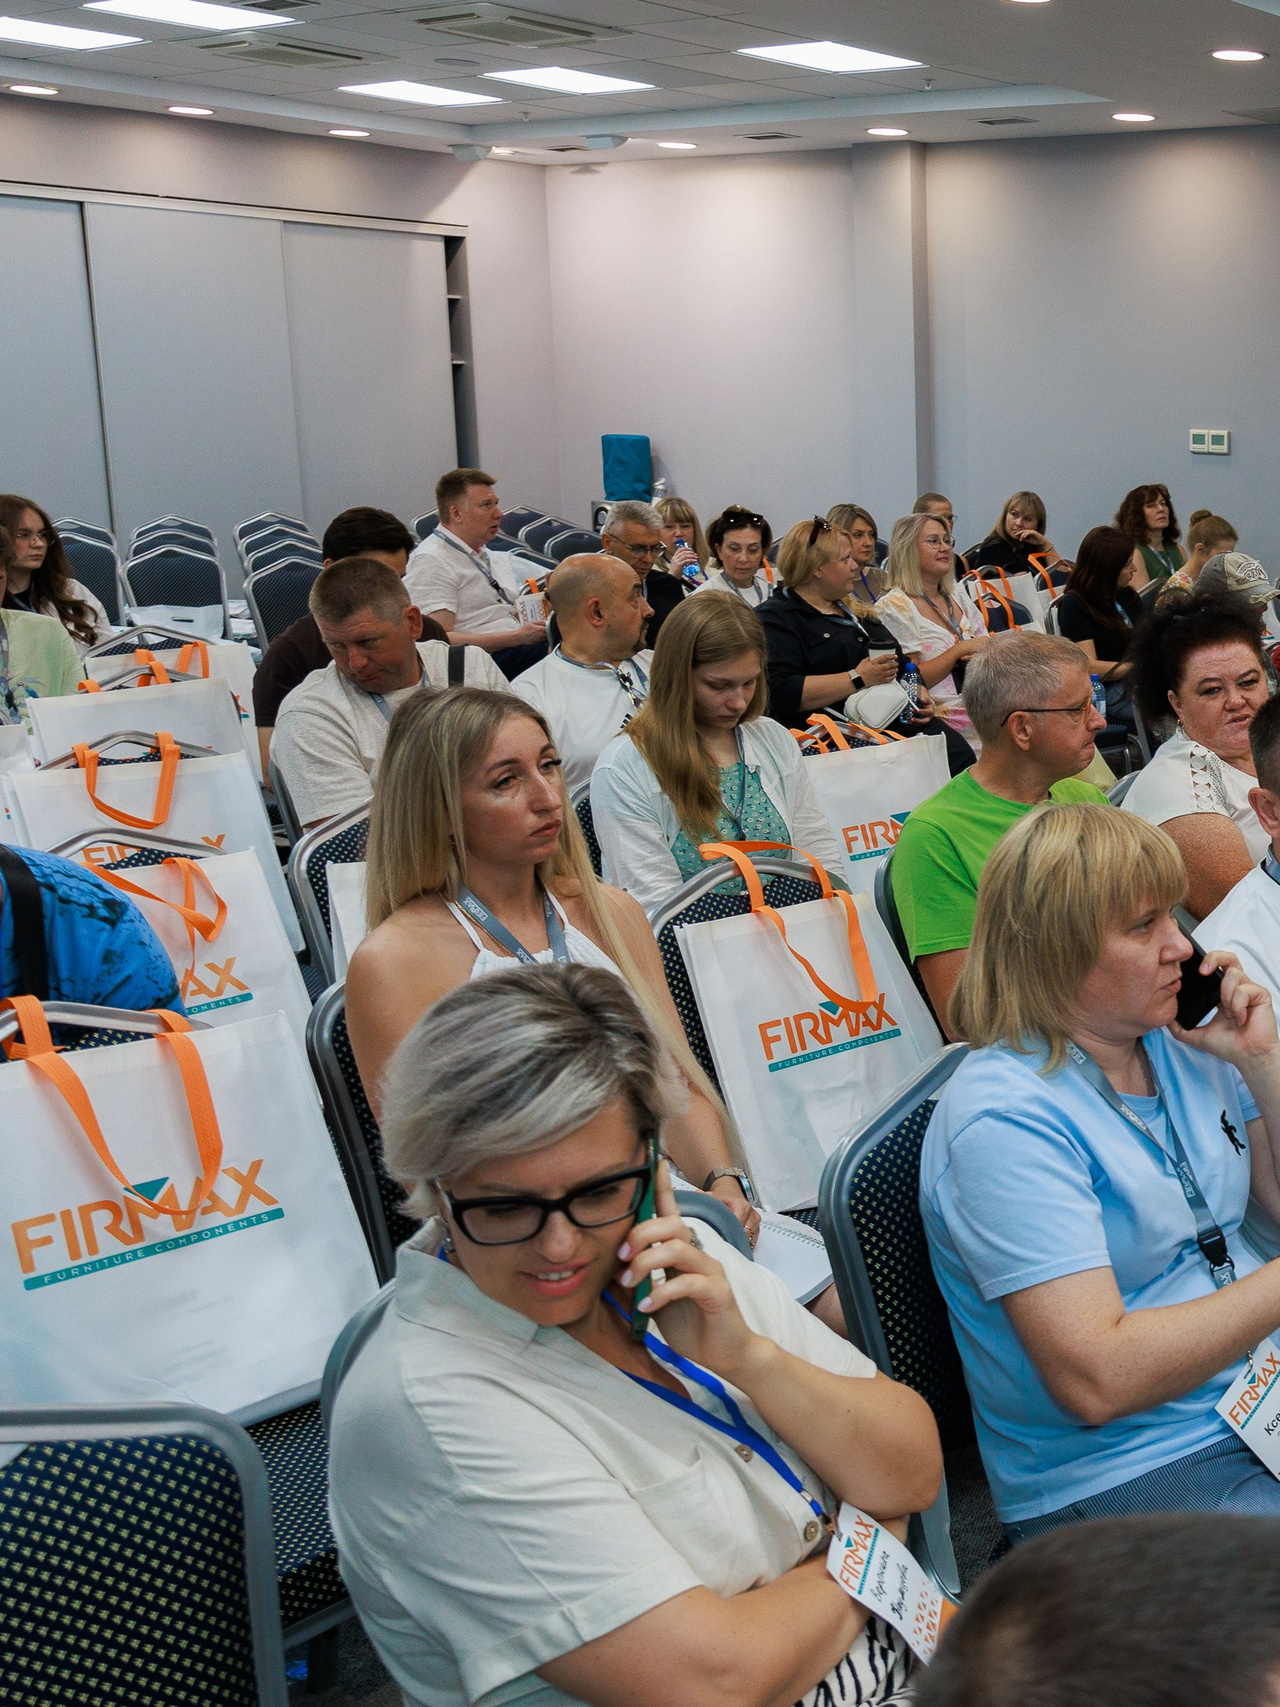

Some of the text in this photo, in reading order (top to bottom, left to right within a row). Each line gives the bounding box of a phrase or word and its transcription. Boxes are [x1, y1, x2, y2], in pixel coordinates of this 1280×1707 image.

[842, 818, 902, 854] FIR
[758, 993, 898, 1061] FIRMAX
[778, 1031, 895, 1069] FURNITURE COMPONENTS
[12, 1159, 279, 1274] FIRMAX
[44, 1213, 269, 1284] FURNITURE COMPONENTS
[839, 1514, 875, 1592] FIRMAX
